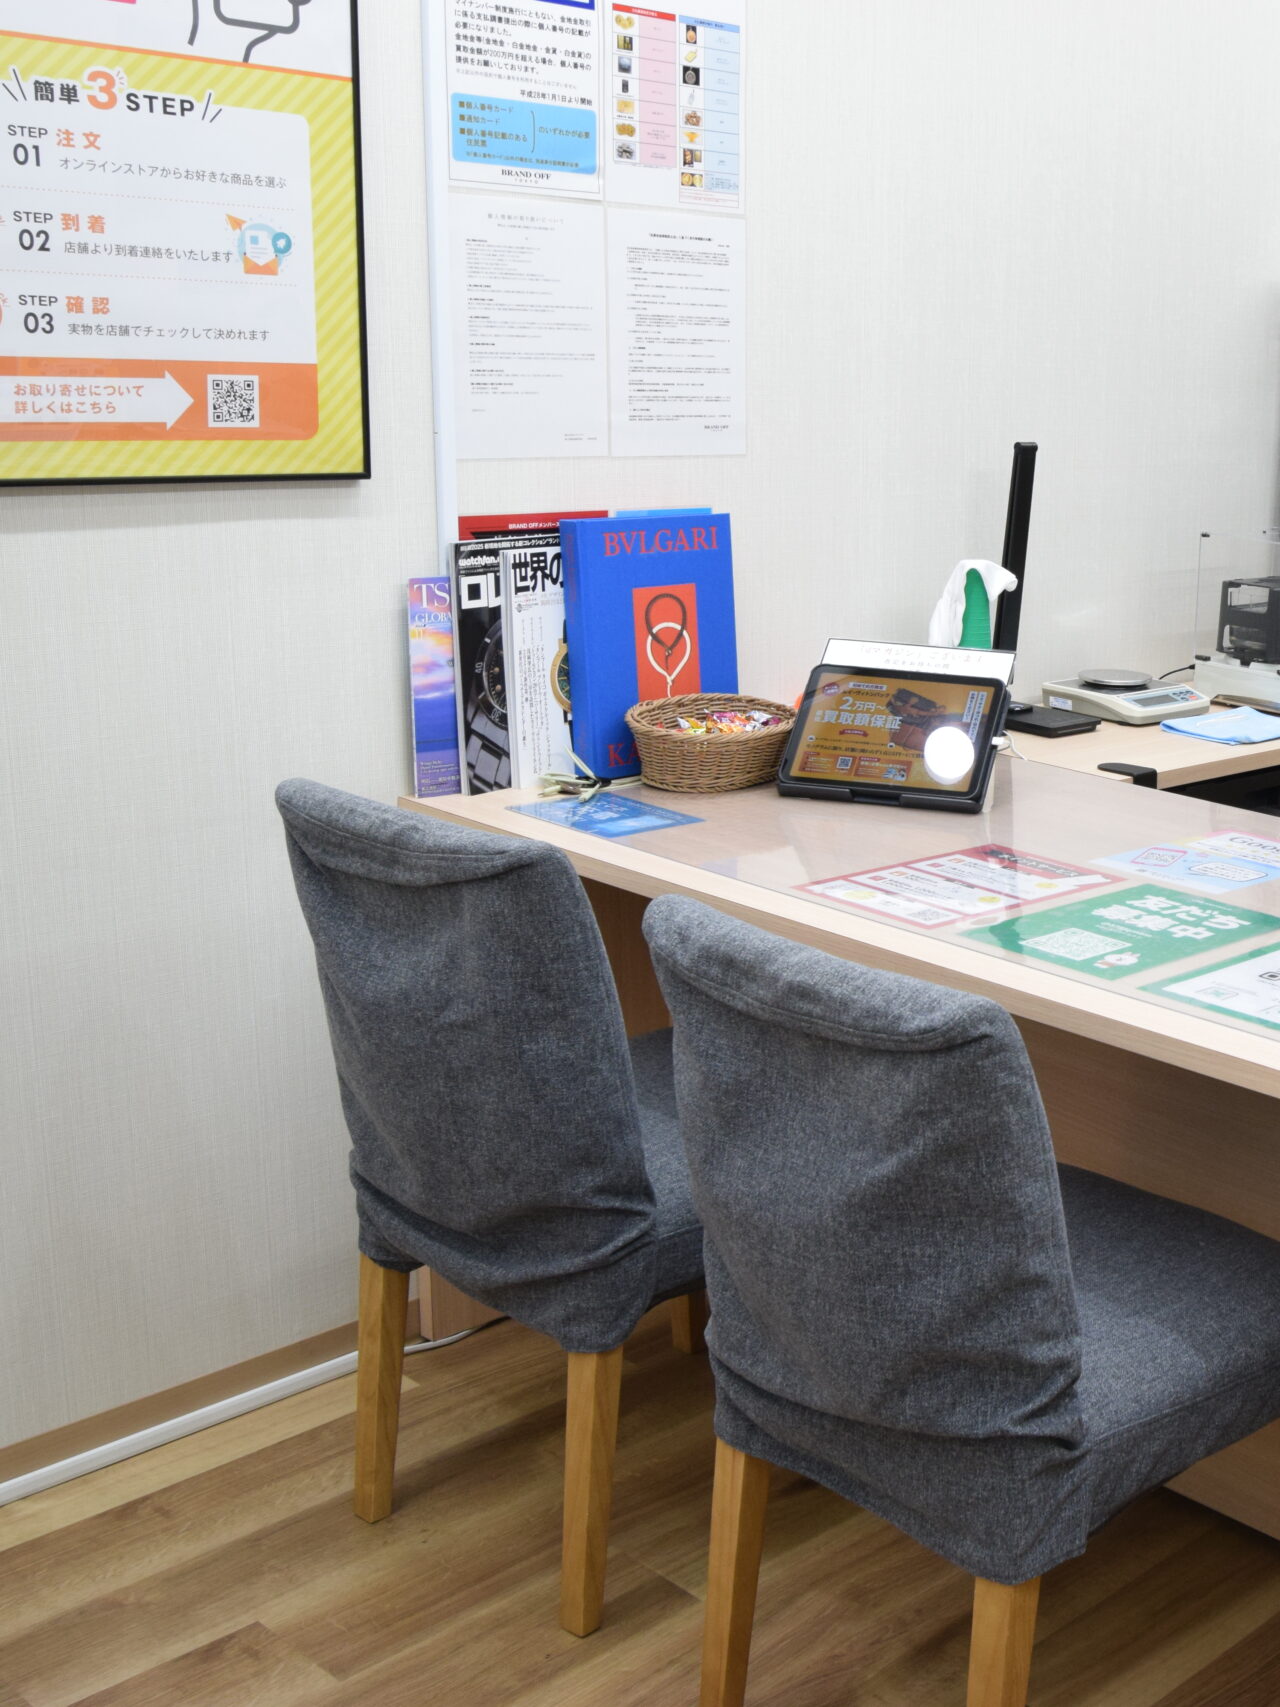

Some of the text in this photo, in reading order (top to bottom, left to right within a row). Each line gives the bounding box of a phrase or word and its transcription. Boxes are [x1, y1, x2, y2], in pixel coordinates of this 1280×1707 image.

[33, 70, 195, 117] 簡単 3 STEP
[7, 124, 48, 139] STEP
[56, 129, 101, 150] 注文
[13, 143, 41, 167] 01
[59, 156, 287, 189] オンラインストアからお好きな商品を選ぶ
[501, 169, 551, 180] BRAND OFF
[13, 211, 53, 224] STEP
[60, 213, 106, 234] 到着
[18, 229, 51, 252] 02
[64, 241, 233, 263] 店舗より到着連絡をいたします
[18, 294, 58, 307] STEP
[65, 296, 111, 315] 確認
[23, 312, 55, 334] 03
[67, 323, 270, 342] 実物を店舗でチェックして決めれます
[13, 384, 145, 397] お取り寄せについて
[14, 400, 117, 414] 詳しくはこちら
[603, 526, 718, 557] BVLGARI
[823, 710, 903, 729] 買取額保証
[1126, 894, 1252, 930] 友だち
